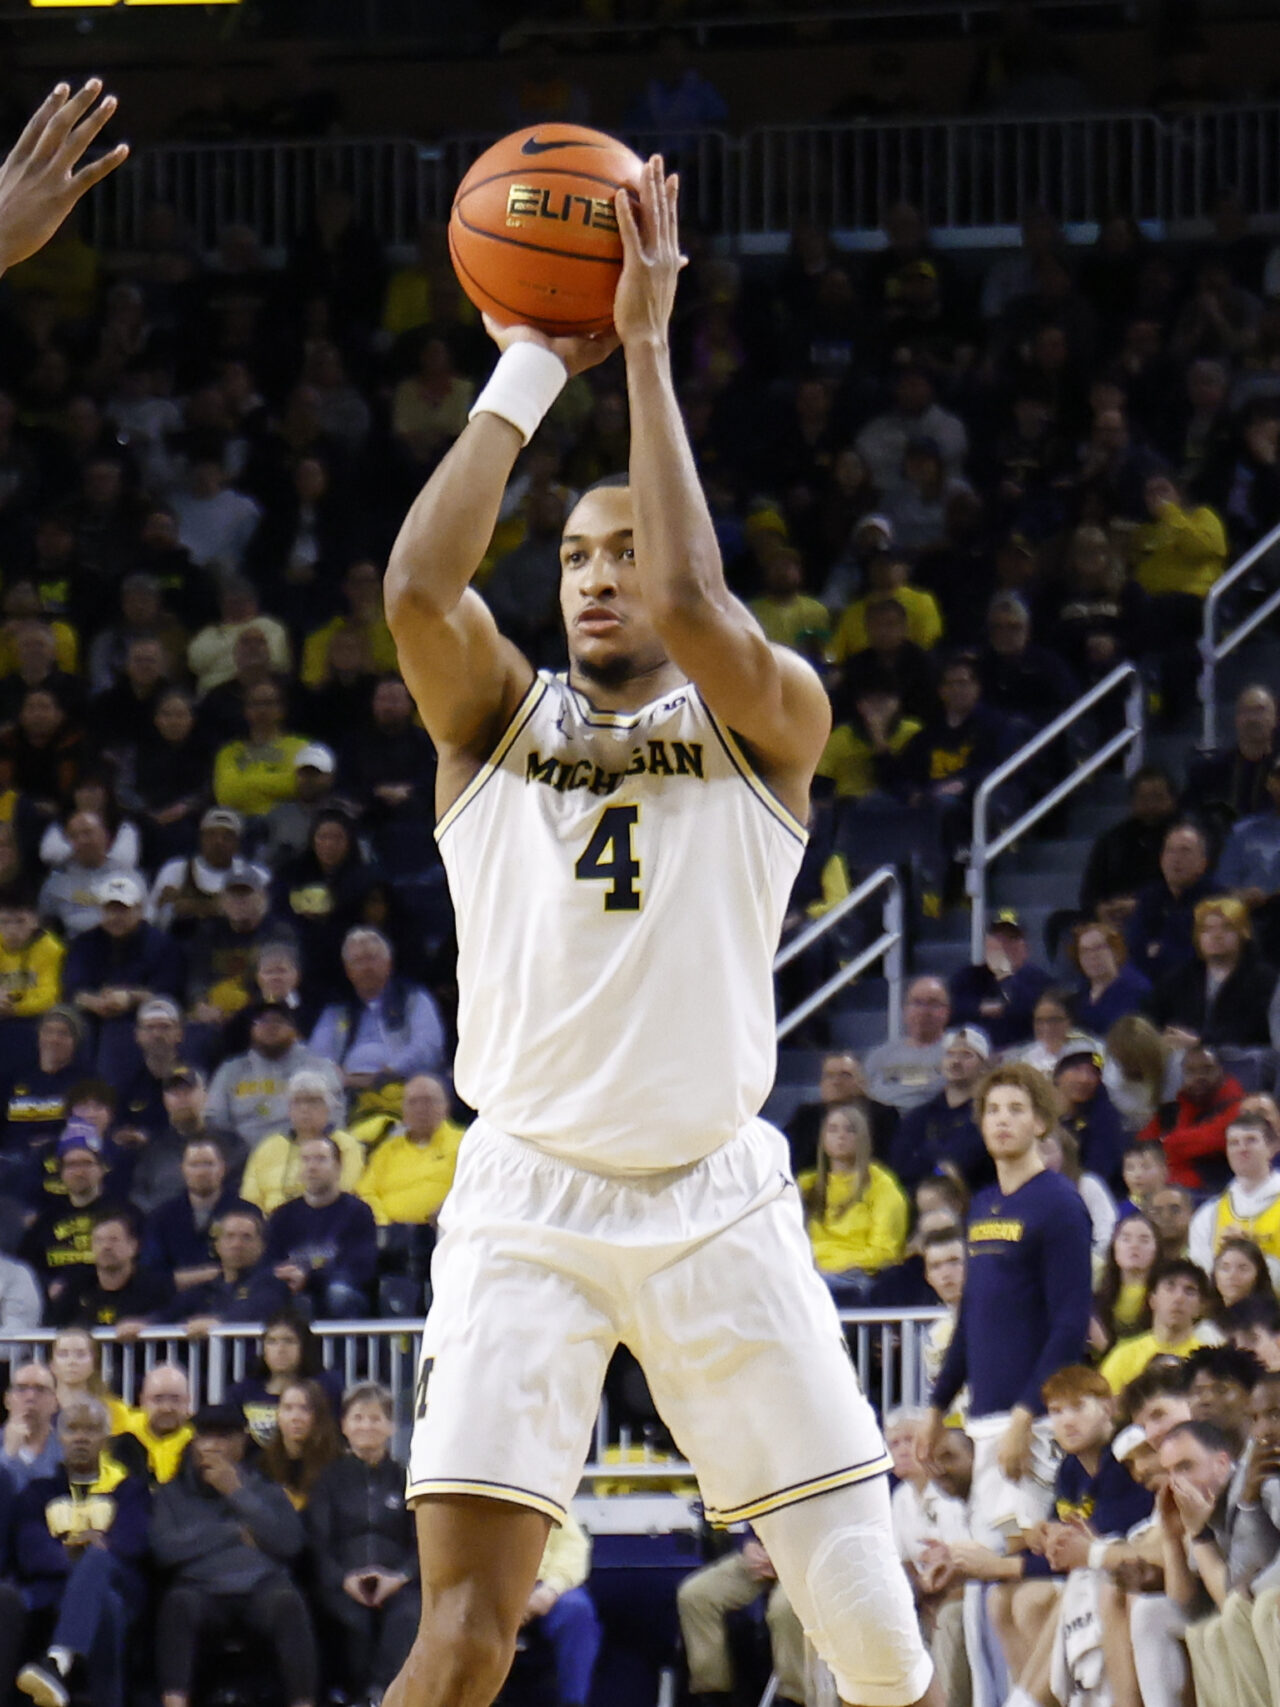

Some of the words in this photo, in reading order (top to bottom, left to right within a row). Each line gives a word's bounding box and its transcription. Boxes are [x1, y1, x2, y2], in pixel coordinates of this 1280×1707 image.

[507, 184, 619, 232] ELITE
[525, 740, 705, 797] MICHGAN
[575, 802, 641, 912] 4
